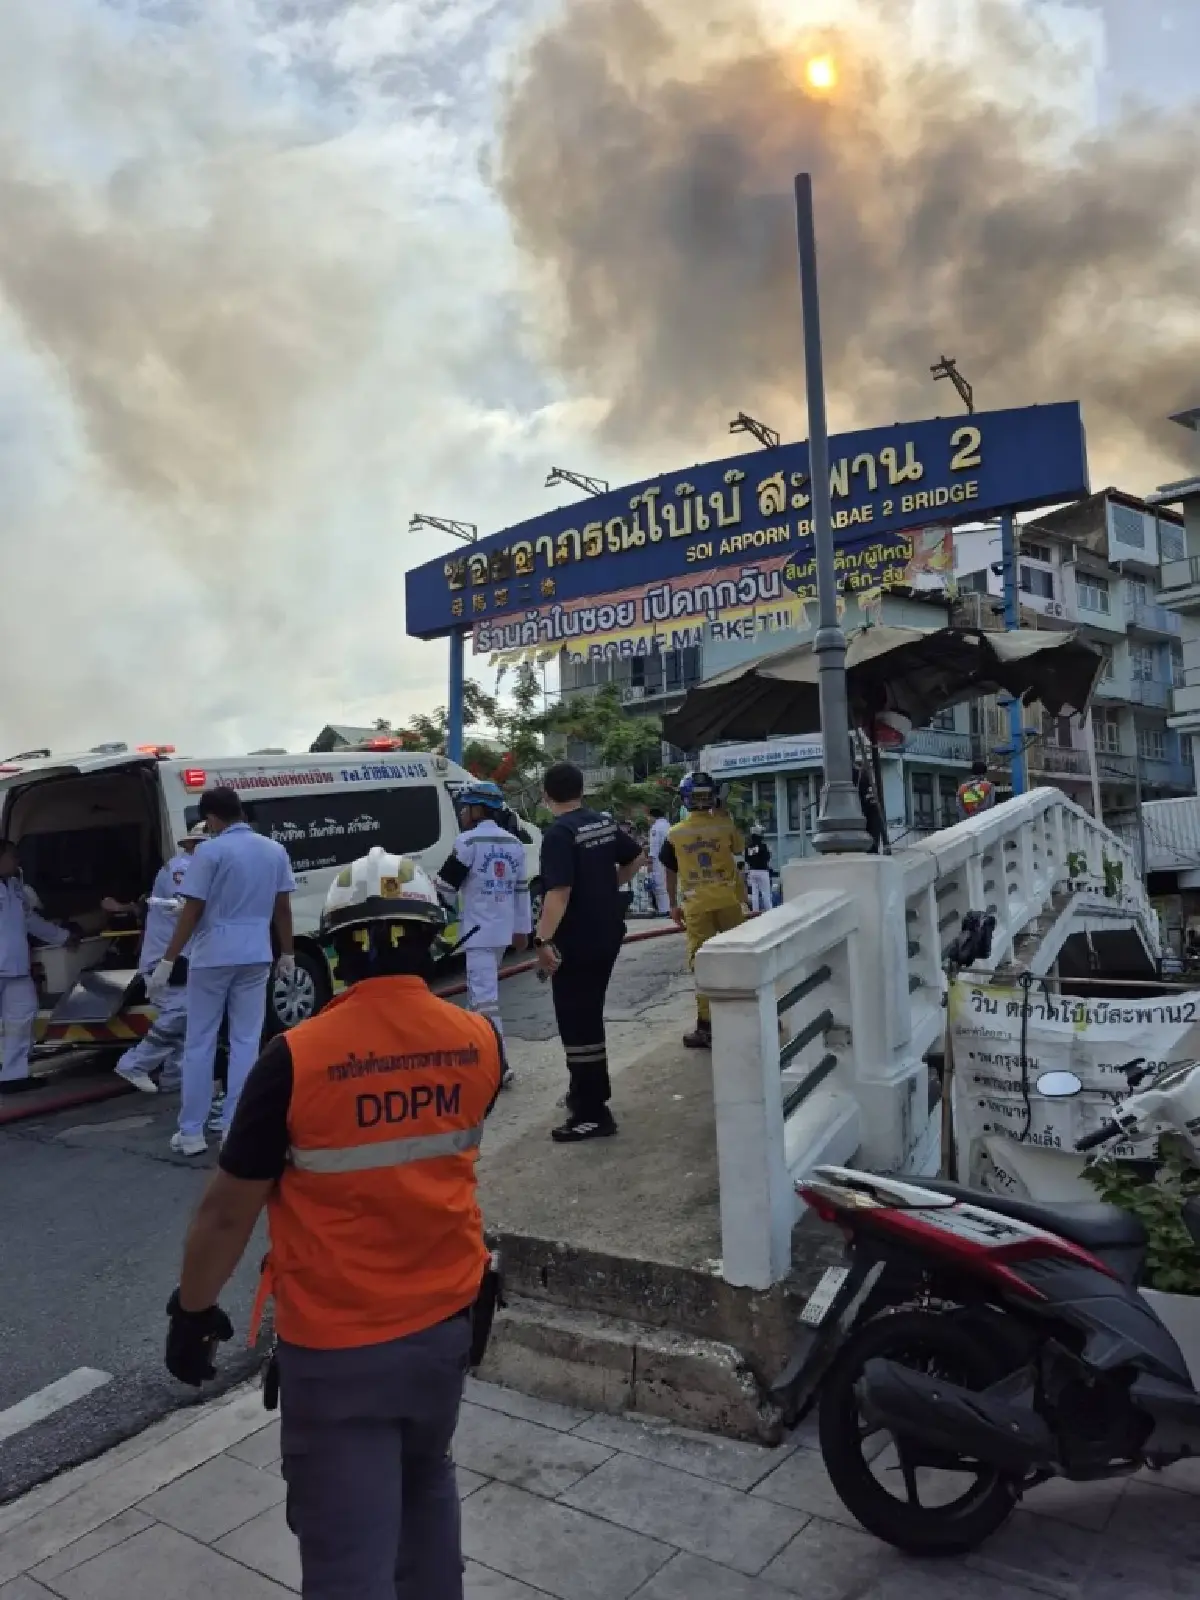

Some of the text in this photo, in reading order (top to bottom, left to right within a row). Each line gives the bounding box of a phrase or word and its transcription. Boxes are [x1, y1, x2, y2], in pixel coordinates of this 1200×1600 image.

[950, 426, 982, 470] 2
[685, 541, 713, 562] SOI
[719, 524, 790, 556] ARPORN
[882, 500, 894, 517] 2
[901, 481, 979, 513] BRIDGE
[475, 567, 782, 652] ร้านค้าในซอย เปิดทุกวัน
[356, 1083, 461, 1128] DDPM
